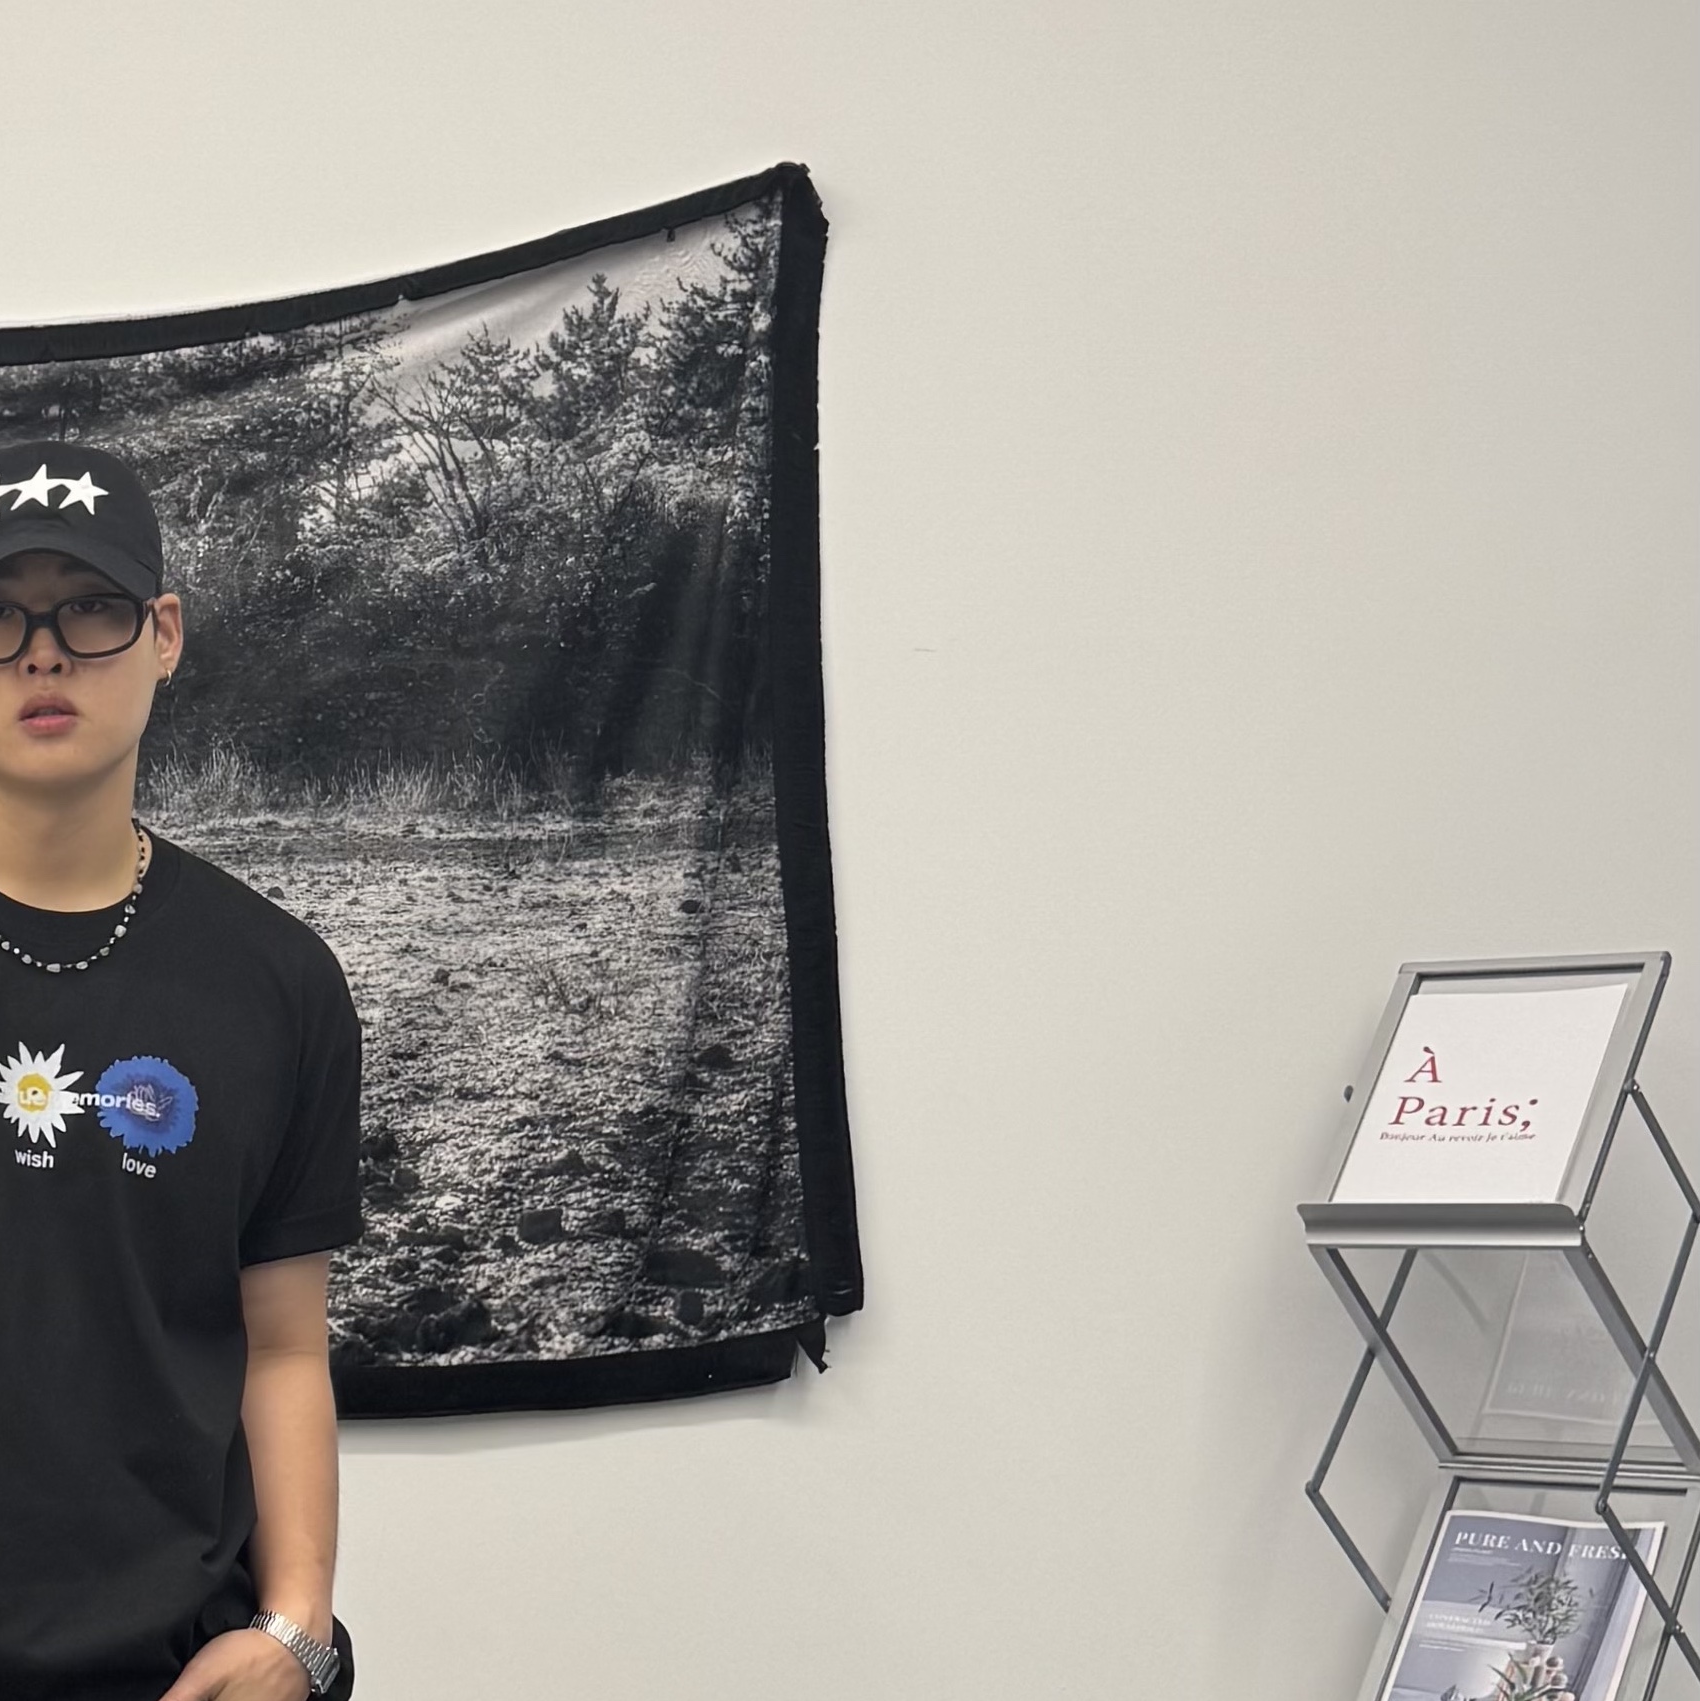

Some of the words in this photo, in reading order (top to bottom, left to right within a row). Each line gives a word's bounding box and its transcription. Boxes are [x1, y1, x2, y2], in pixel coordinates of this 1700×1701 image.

[1404, 1046, 1442, 1083] À
[14, 1149, 54, 1169] wish
[122, 1152, 157, 1179] love
[1455, 1531, 1511, 1549] PURE
[1515, 1538, 1562, 1556] AND
[1567, 1544, 1627, 1560] FRES
